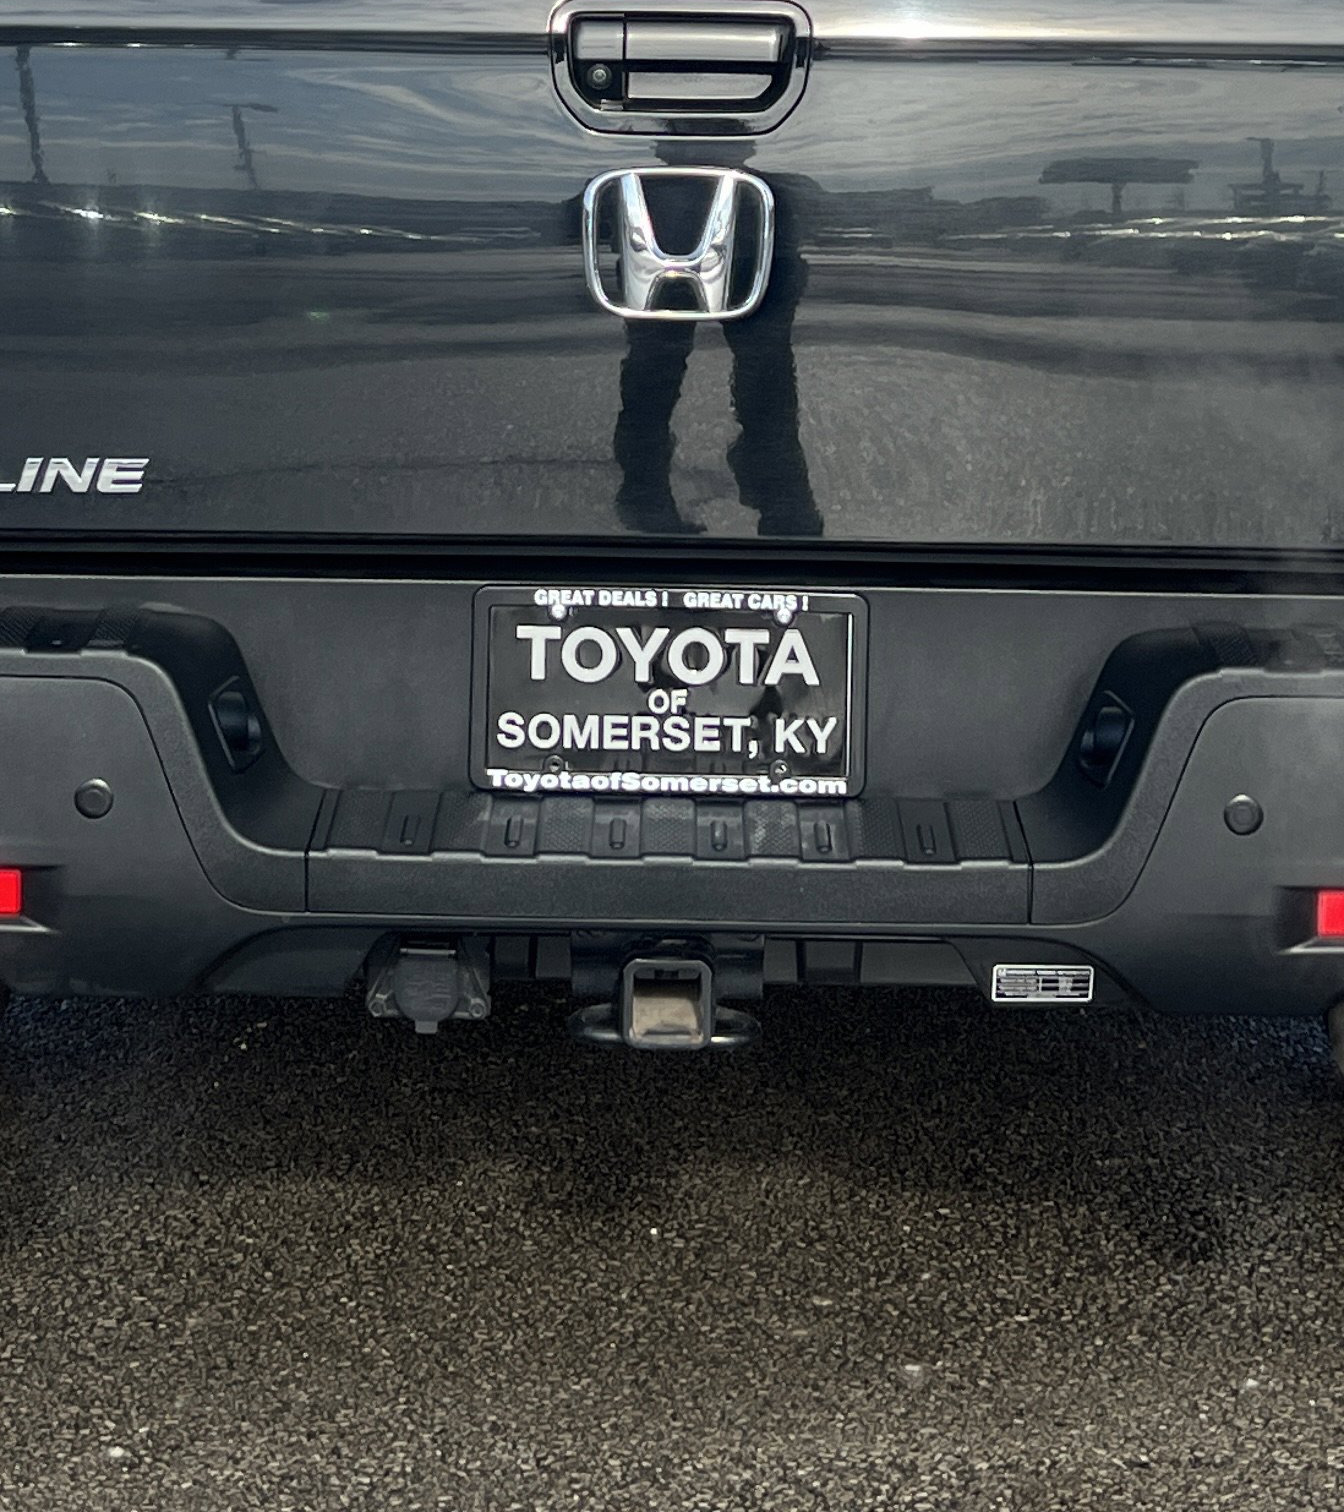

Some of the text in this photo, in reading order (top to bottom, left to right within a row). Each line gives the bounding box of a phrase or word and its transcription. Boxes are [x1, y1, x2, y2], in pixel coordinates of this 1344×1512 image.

[534, 589, 594, 606] GREAT
[683, 592, 744, 609] GREAT
[516, 625, 820, 686] TOYOTA
[648, 689, 688, 714] OF
[496, 711, 838, 759] SOMERSET, KY
[486, 769, 848, 795] ToyotaofSomerset.com
